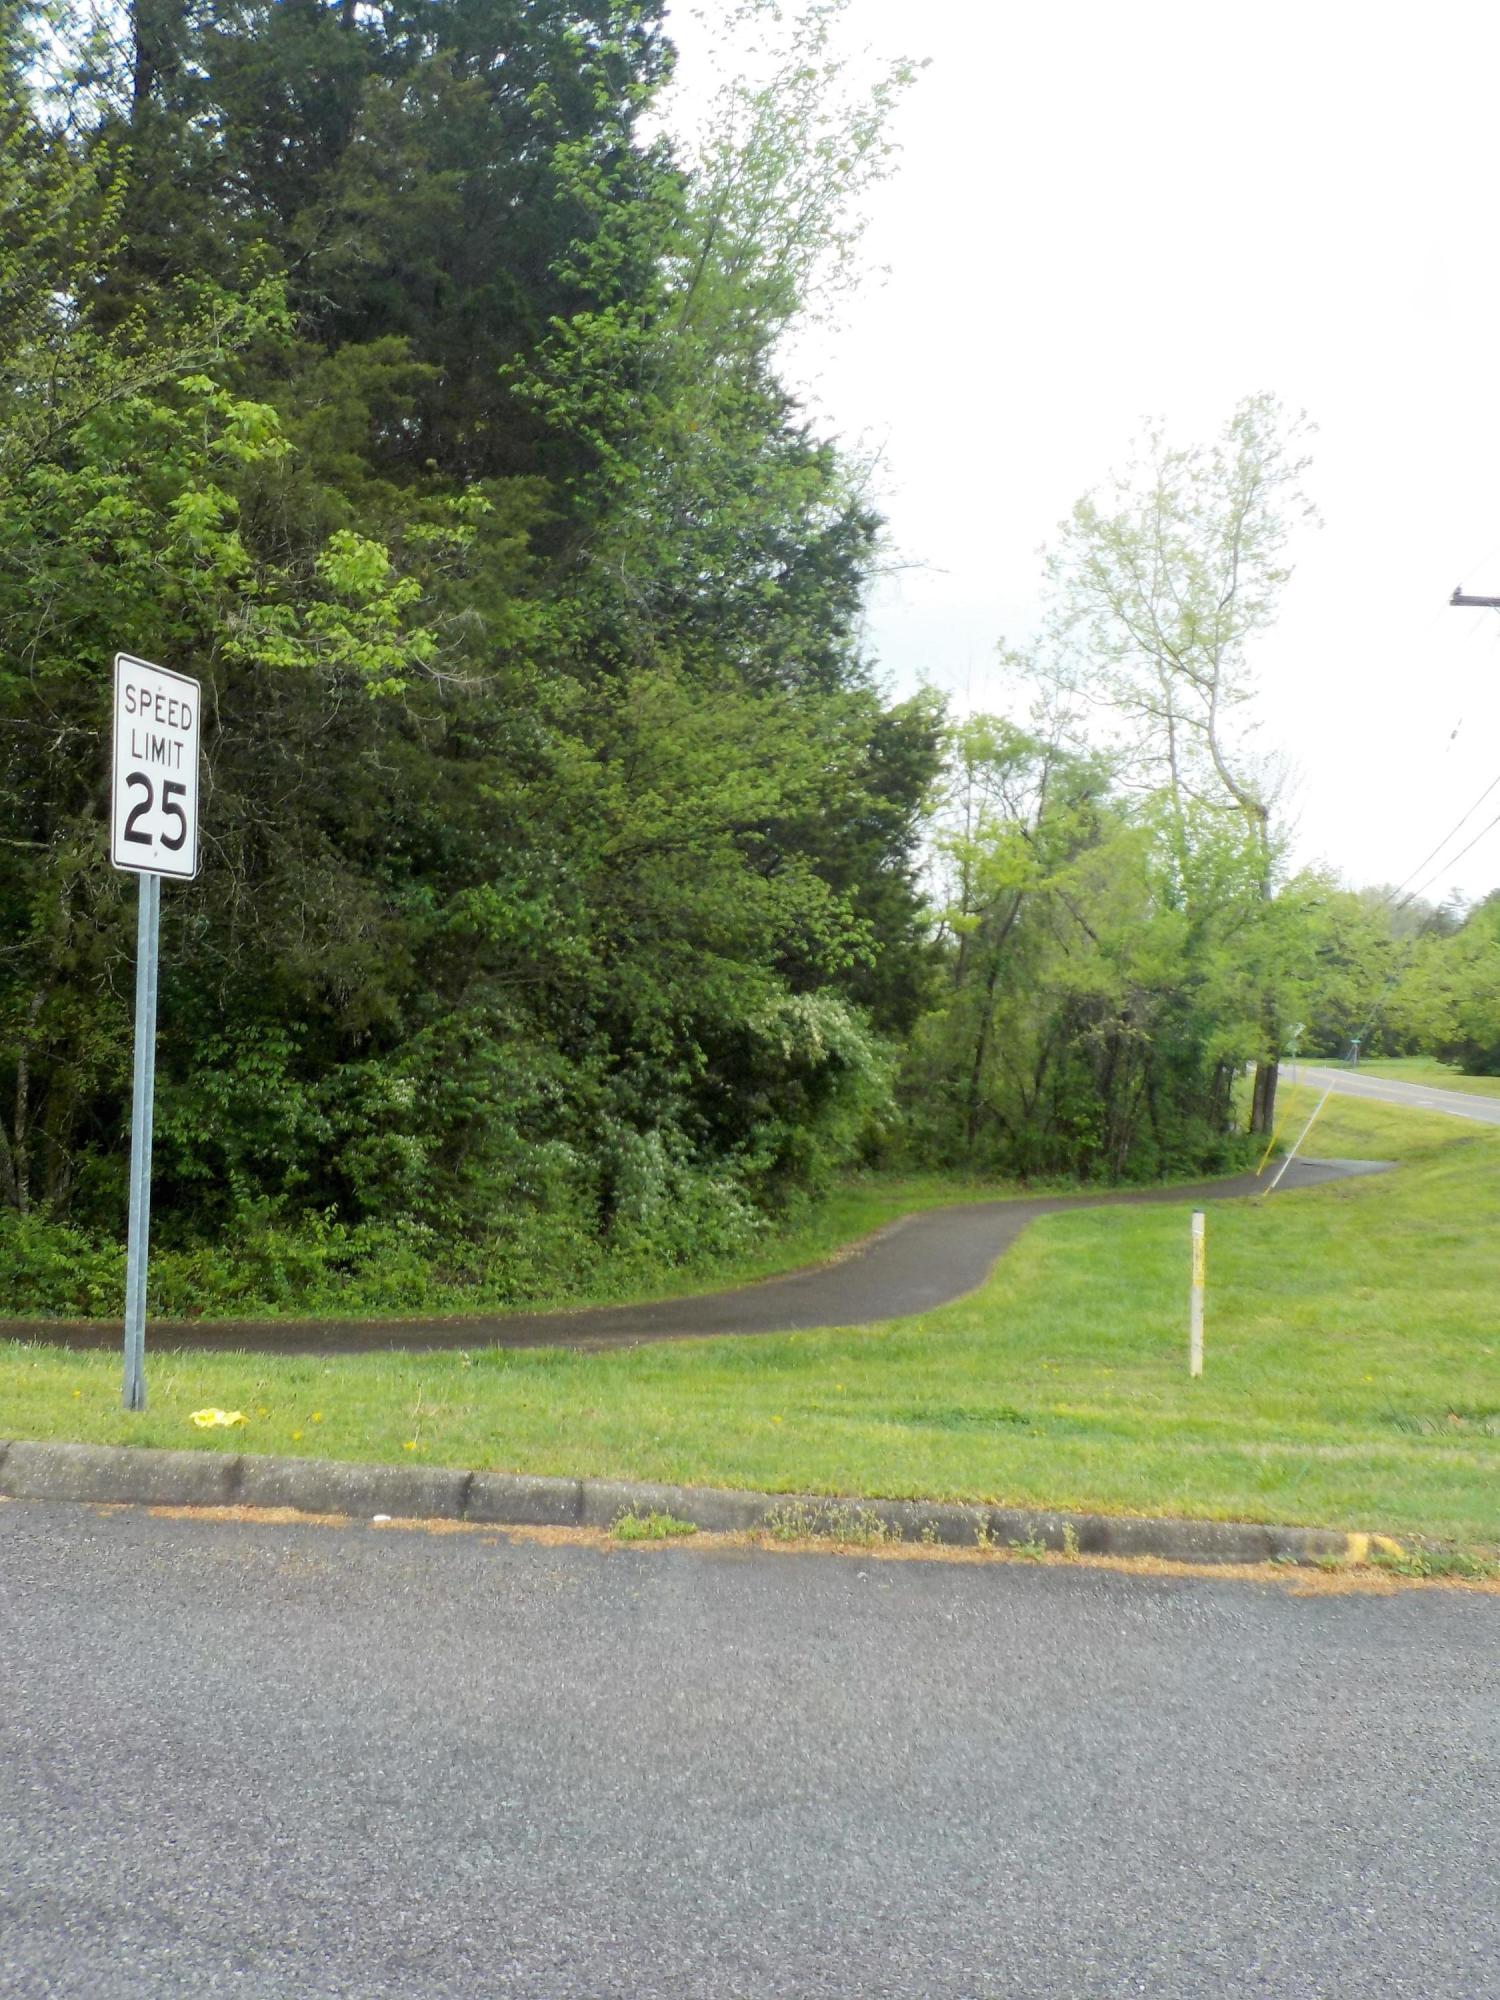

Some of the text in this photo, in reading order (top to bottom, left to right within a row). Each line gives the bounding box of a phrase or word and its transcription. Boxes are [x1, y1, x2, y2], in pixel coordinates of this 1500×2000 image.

[125, 684, 192, 731] SPEED
[131, 728, 184, 769] LIMIT
[123, 771, 187, 851] 25
